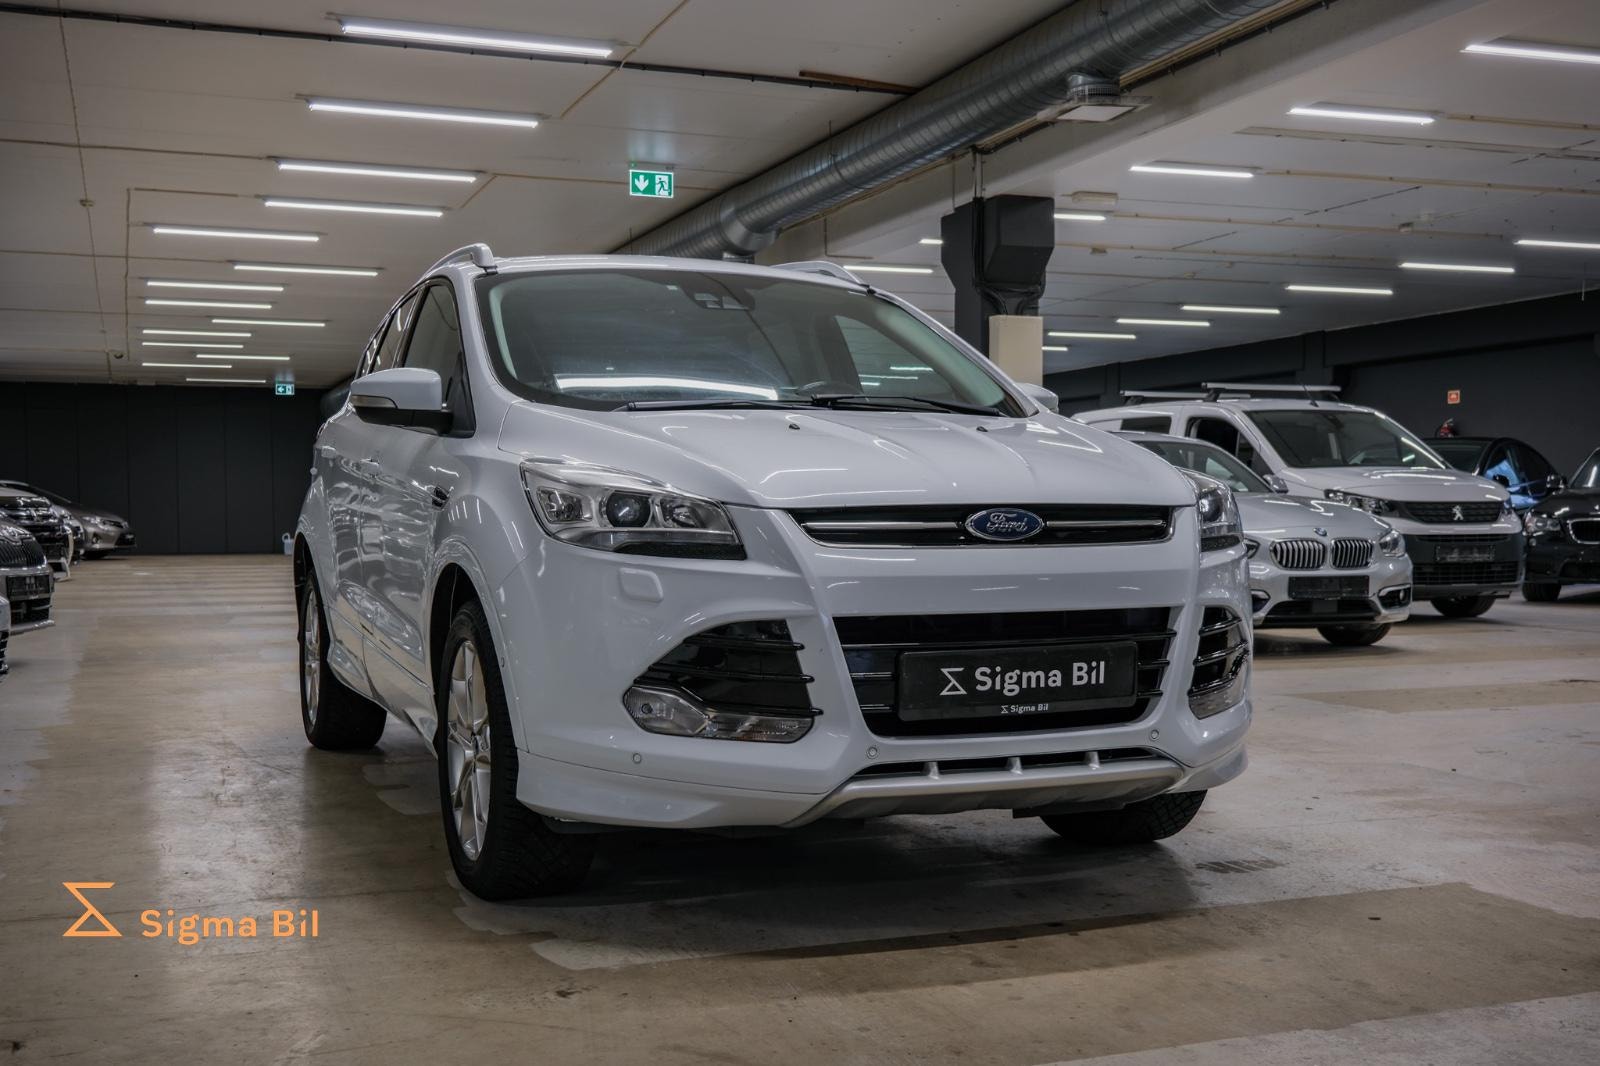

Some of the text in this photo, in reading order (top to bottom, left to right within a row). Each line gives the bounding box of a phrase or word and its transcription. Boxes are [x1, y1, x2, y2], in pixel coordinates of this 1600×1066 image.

[986, 512, 1028, 533] Ford
[974, 660, 1106, 696] Sigma Bil
[1010, 703, 1049, 714] Sigma Bil
